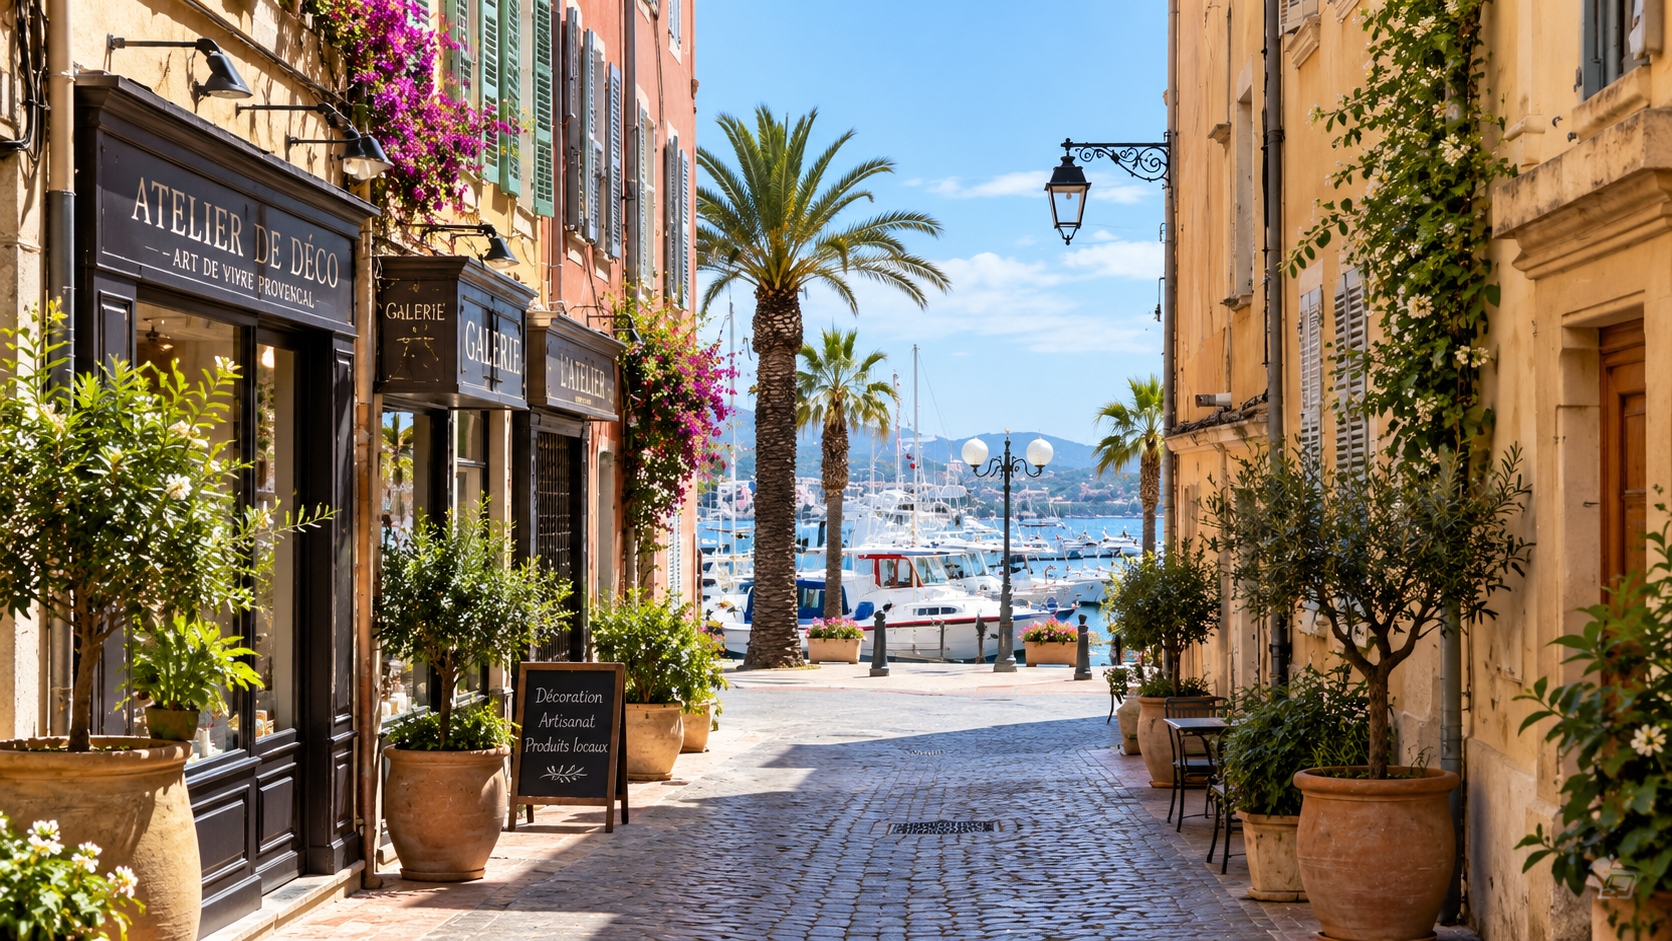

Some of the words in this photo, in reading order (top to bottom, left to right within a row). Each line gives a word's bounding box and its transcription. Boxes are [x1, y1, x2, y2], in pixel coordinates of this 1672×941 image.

[131, 177, 244, 257] ATELIER
[254, 223, 282, 270] DE
[290, 234, 339, 288] DÉCO
[173, 248, 198, 272] ART
[203, 257, 219, 279] DE
[465, 320, 520, 375] GALERIE
[535, 687, 603, 704] Décoration
[538, 711, 595, 728] Artisanat
[525, 736, 570, 753] Produits
[573, 736, 608, 753] locaux
